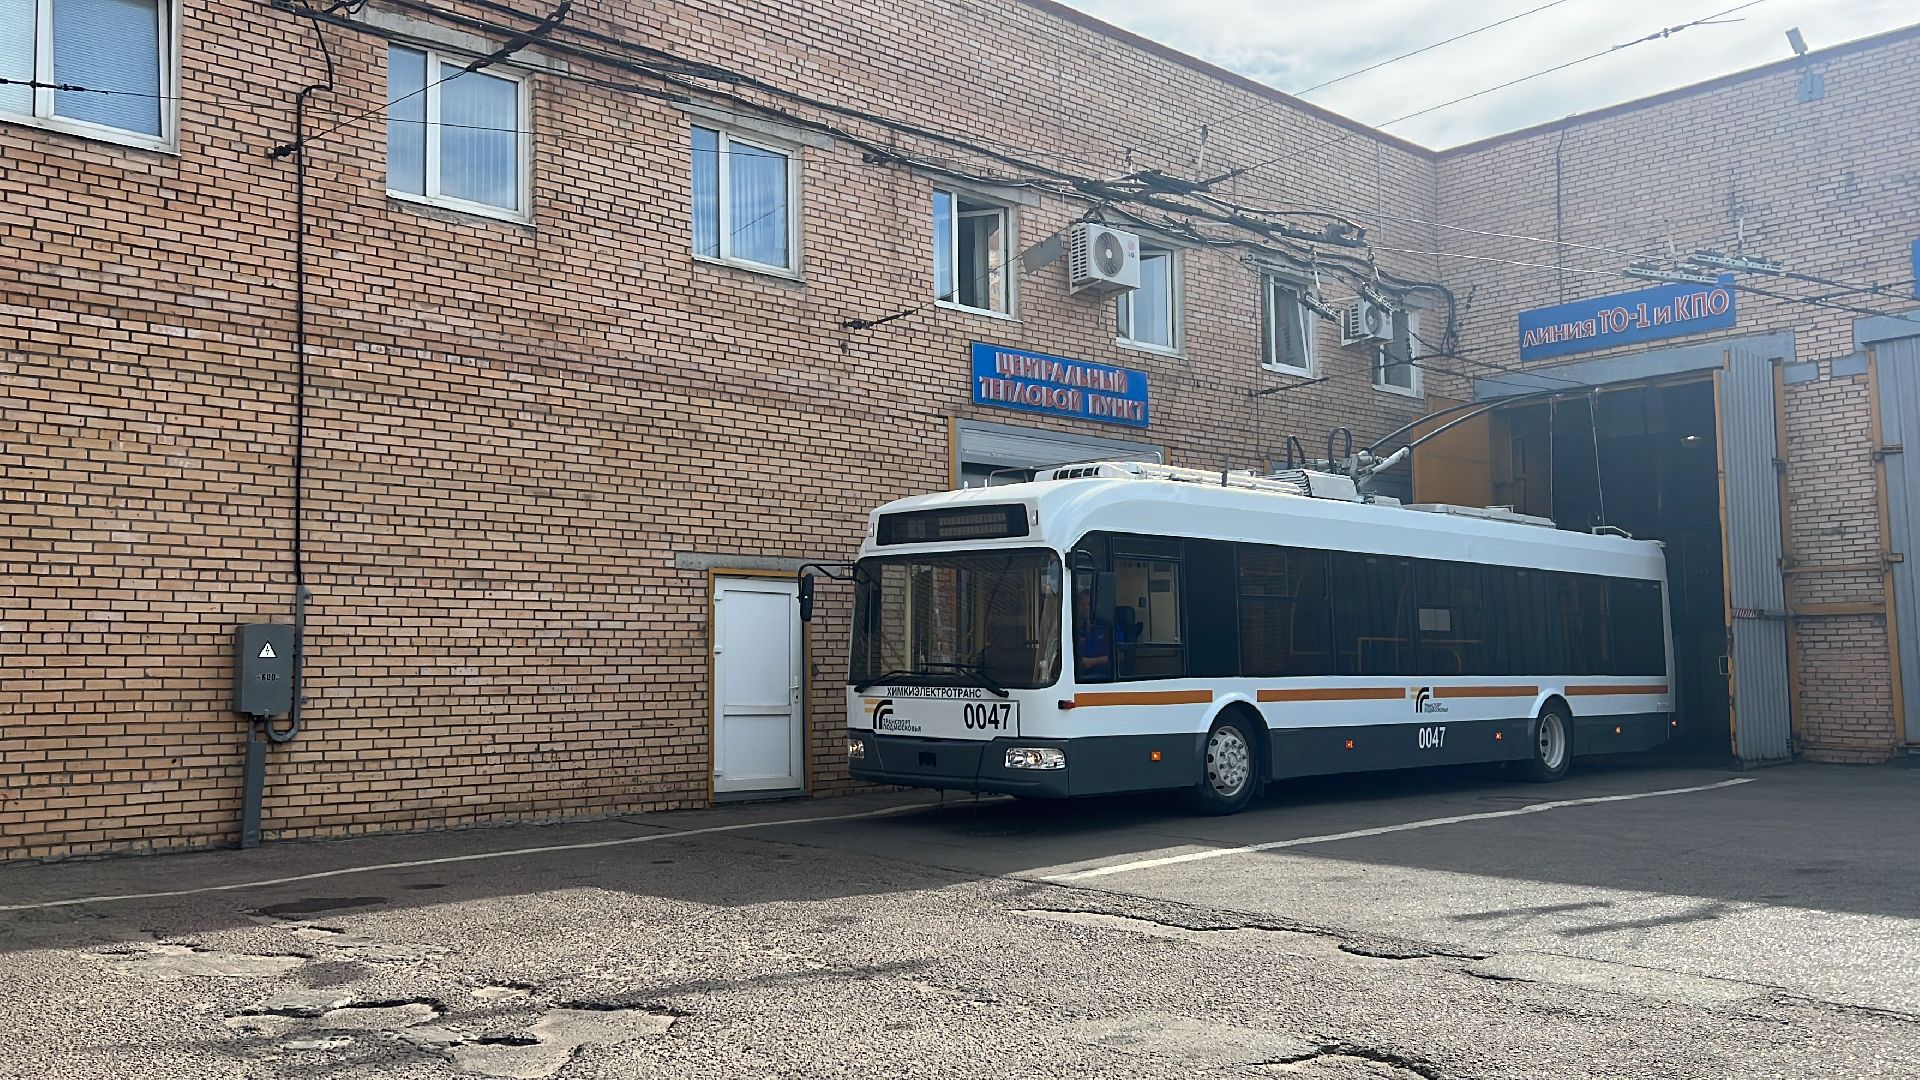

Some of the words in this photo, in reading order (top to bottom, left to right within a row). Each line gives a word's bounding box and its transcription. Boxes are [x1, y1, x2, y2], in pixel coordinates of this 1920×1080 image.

[1598, 302, 1650, 334] ТО-1
[1674, 288, 1730, 322] КПО
[995, 351, 1128, 394] ЦЕНТРАЛЬНЫЙ
[979, 376, 1083, 413] ТЕПЛОВОЙ
[1088, 393, 1146, 421] ПУНКТ
[886, 686, 982, 698] ХИМКИЭЛЕКТРОТРАНС
[963, 703, 1011, 730] 0047
[1418, 726, 1446, 749] 0047
